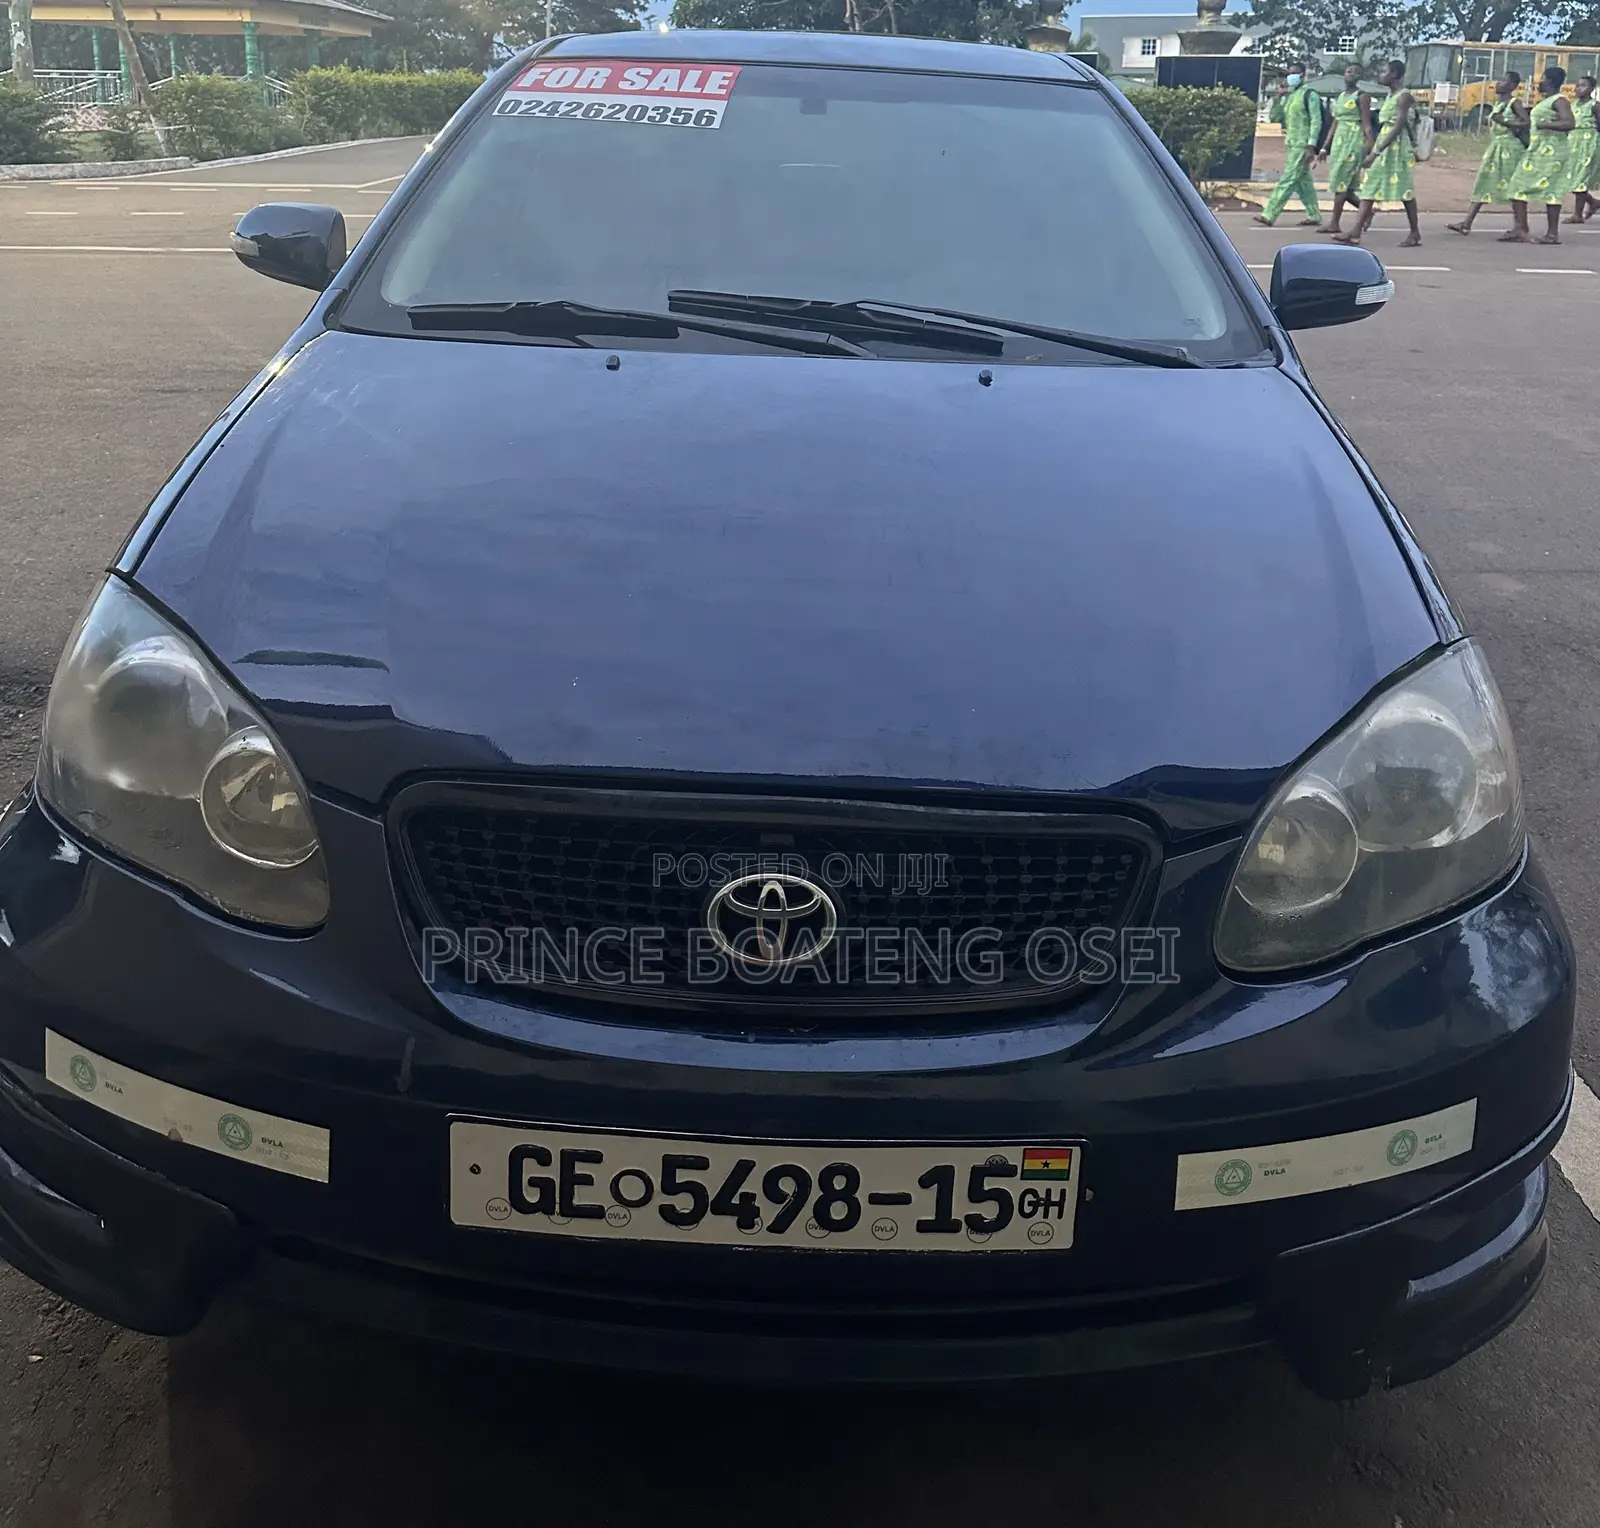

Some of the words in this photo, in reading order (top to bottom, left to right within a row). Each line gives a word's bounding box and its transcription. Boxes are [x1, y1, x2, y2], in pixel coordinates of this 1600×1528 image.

[517, 66, 612, 89] FOR
[618, 66, 734, 95] SALE
[499, 99, 718, 127] 0242620356
[261, 1137, 285, 1149] DVLA
[1263, 1167, 1287, 1177] DVLA
[658, 1153, 1018, 1234] 5498-15
[488, 1205, 509, 1213] DVLA
[1018, 1187, 1067, 1220] GH
[607, 1212, 628, 1220] DVLA
[874, 1225, 895, 1233] DVLA
